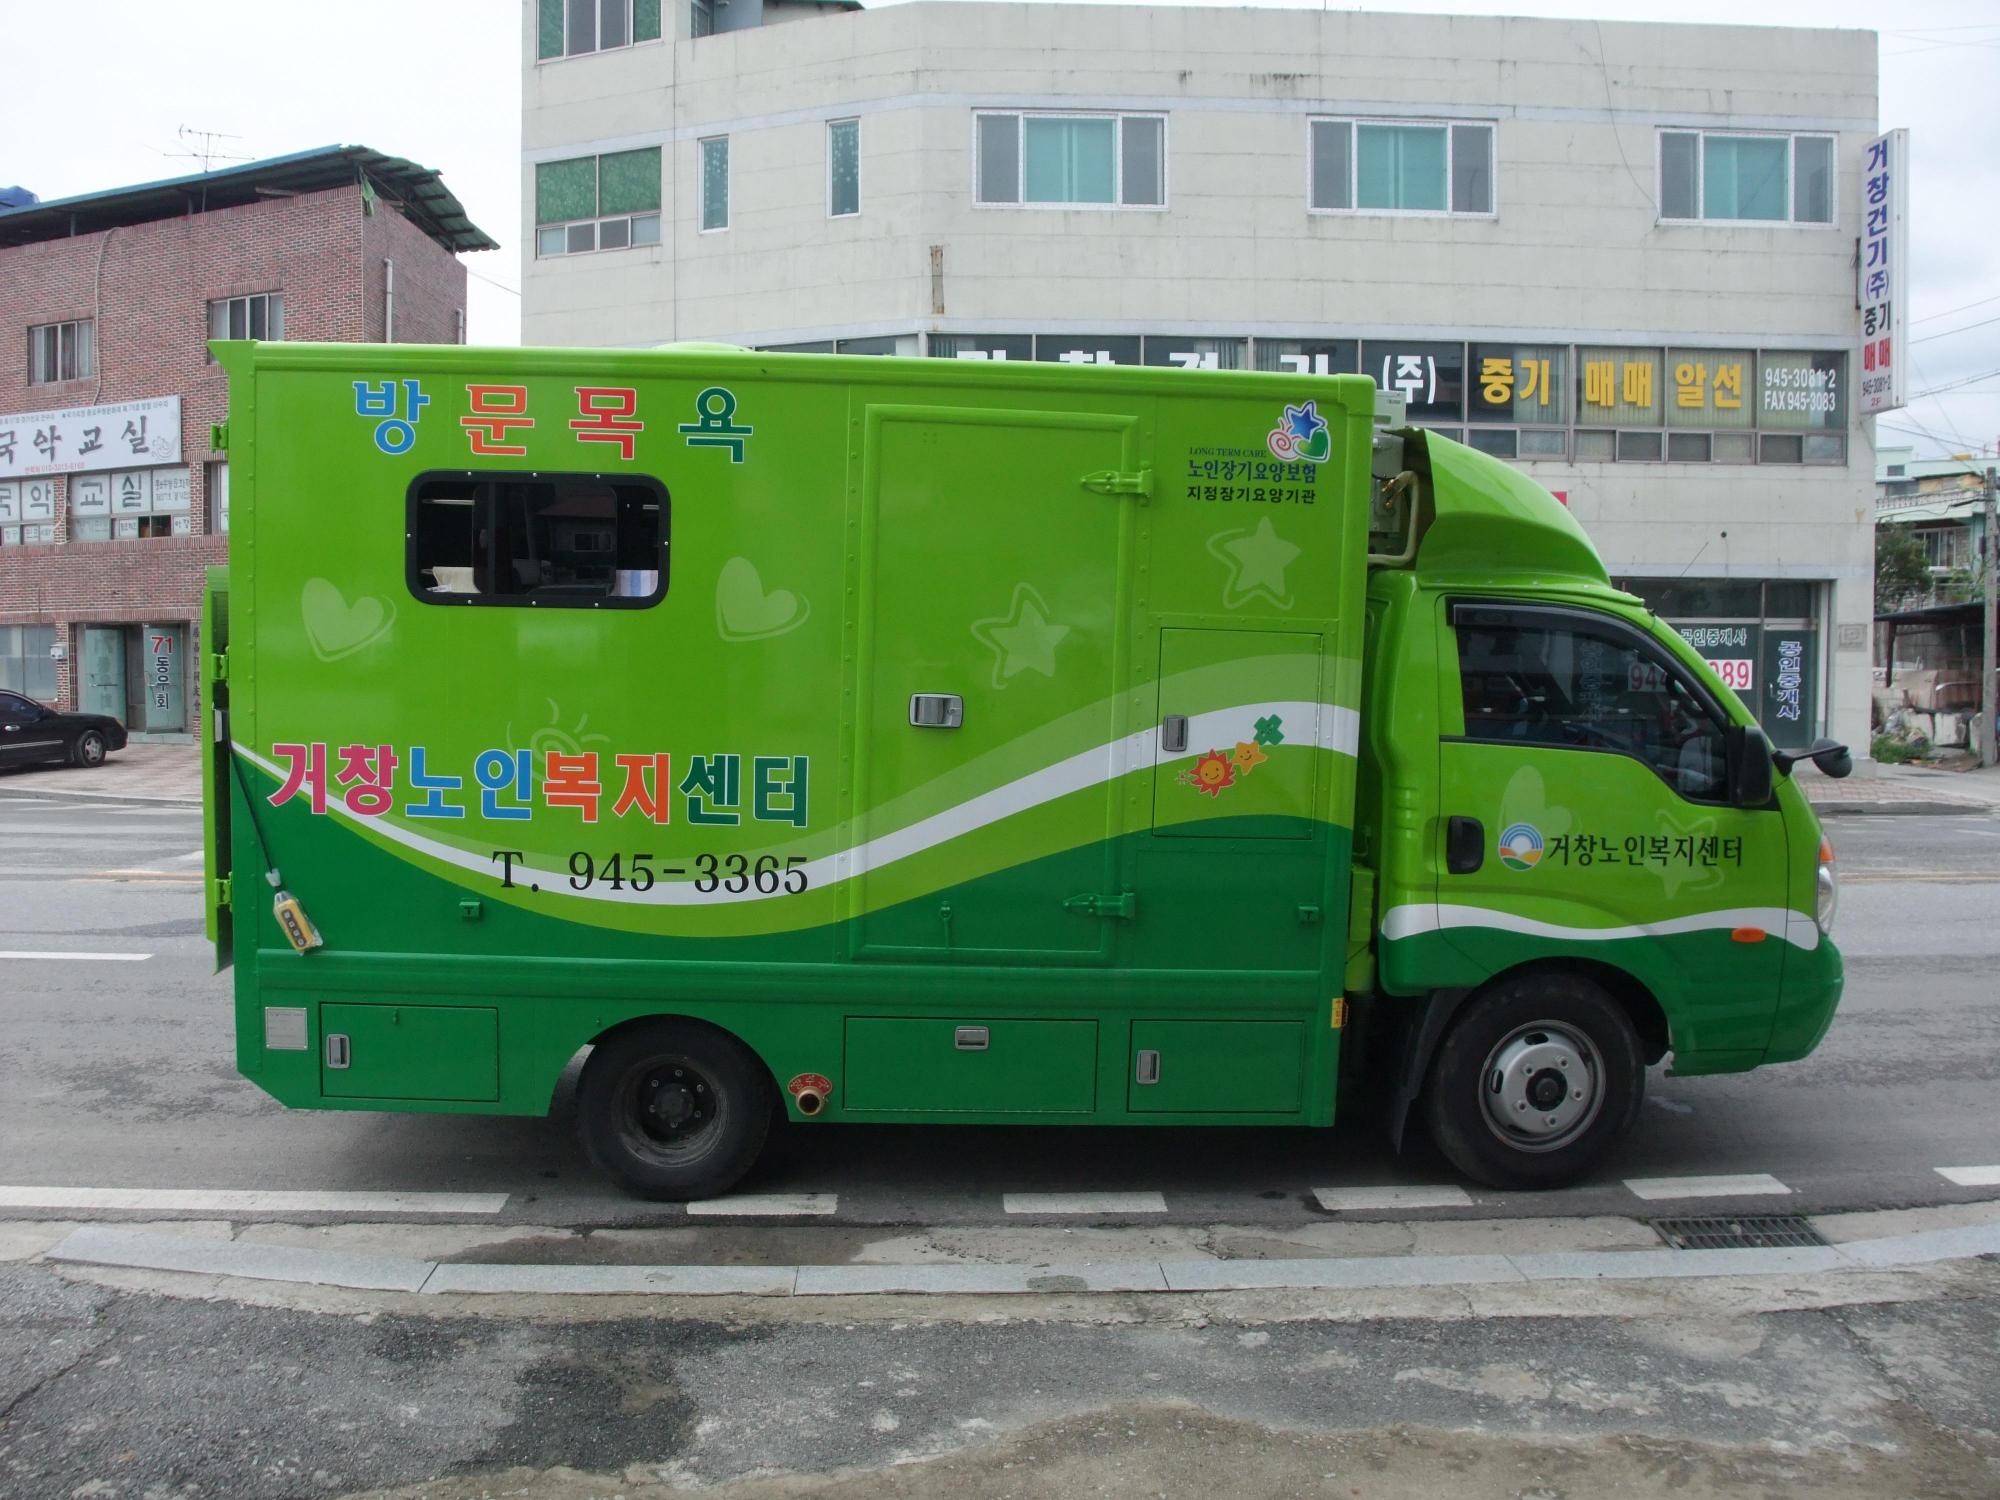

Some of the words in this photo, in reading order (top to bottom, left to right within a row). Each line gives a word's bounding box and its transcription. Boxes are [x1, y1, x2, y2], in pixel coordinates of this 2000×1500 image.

[1864, 301, 1891, 337] 중기
[1864, 337, 1891, 371] 매매
[1480, 358, 1550, 405] 중기
[1585, 360, 1653, 408] 매매
[1675, 362, 1742, 409] 알선
[1765, 367, 1836, 388] 945-3081-2
[1764, 390, 1786, 410] FAX
[1787, 391, 1836, 411] 945-3083
[1190, 447, 1214, 456] LONG
[1216, 448, 1241, 457] TERM
[1243, 449, 1266, 458] CARE
[1187, 459, 1317, 484] 노인장기요양보험
[1187, 485, 1316, 504] 지정장기요양기관
[151, 636, 174, 655] 71
[1680, 628, 1747, 646] 공인중개사
[156, 656, 170, 710] 동우회
[1776, 641, 1802, 720] 공인중개사
[266, 742, 810, 829] 거창노인복지센터
[1548, 834, 1743, 868] 거창노인복지센터
[568, 851, 809, 895] 945-3365
